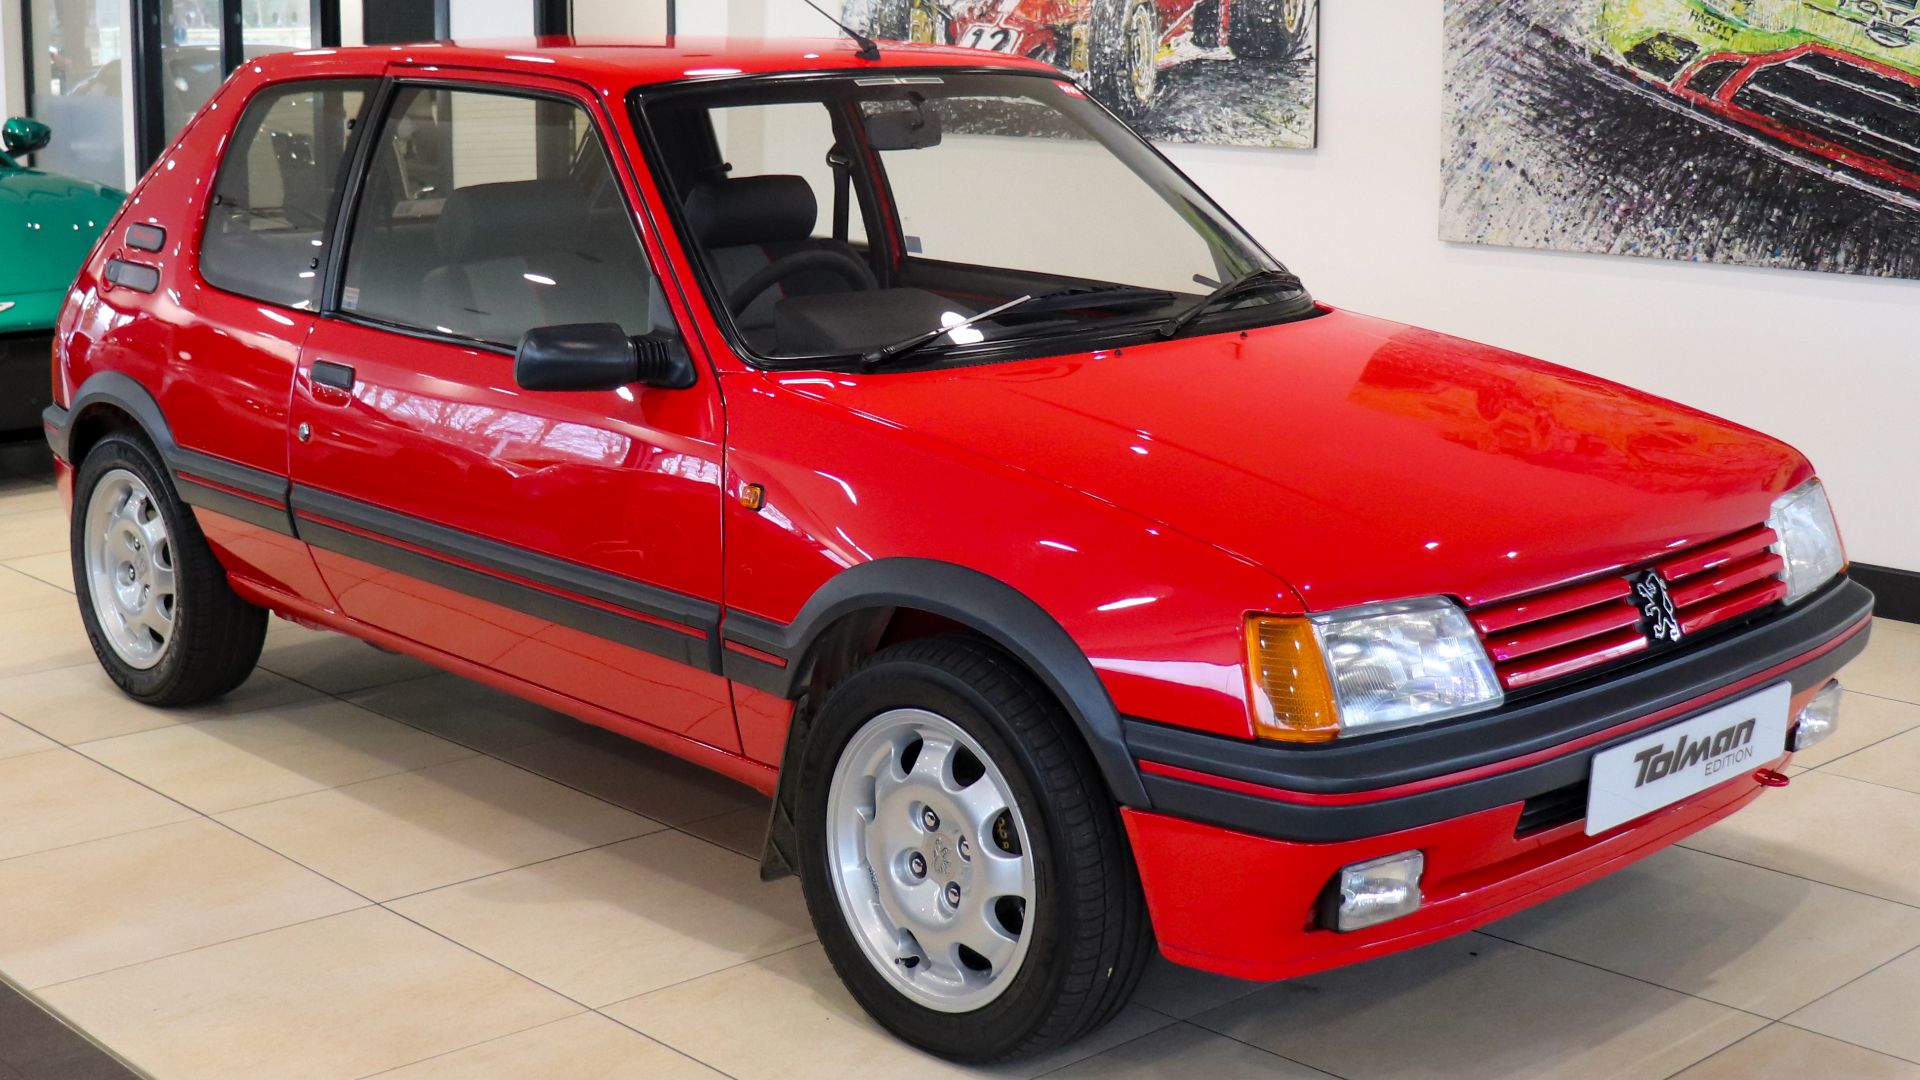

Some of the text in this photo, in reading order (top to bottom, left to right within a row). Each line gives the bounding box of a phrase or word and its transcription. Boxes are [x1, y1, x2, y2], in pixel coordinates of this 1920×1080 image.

[970, 28, 1011, 50] 12
[1634, 718, 1756, 788] Tolman
[1704, 746, 1753, 776] EDITION
